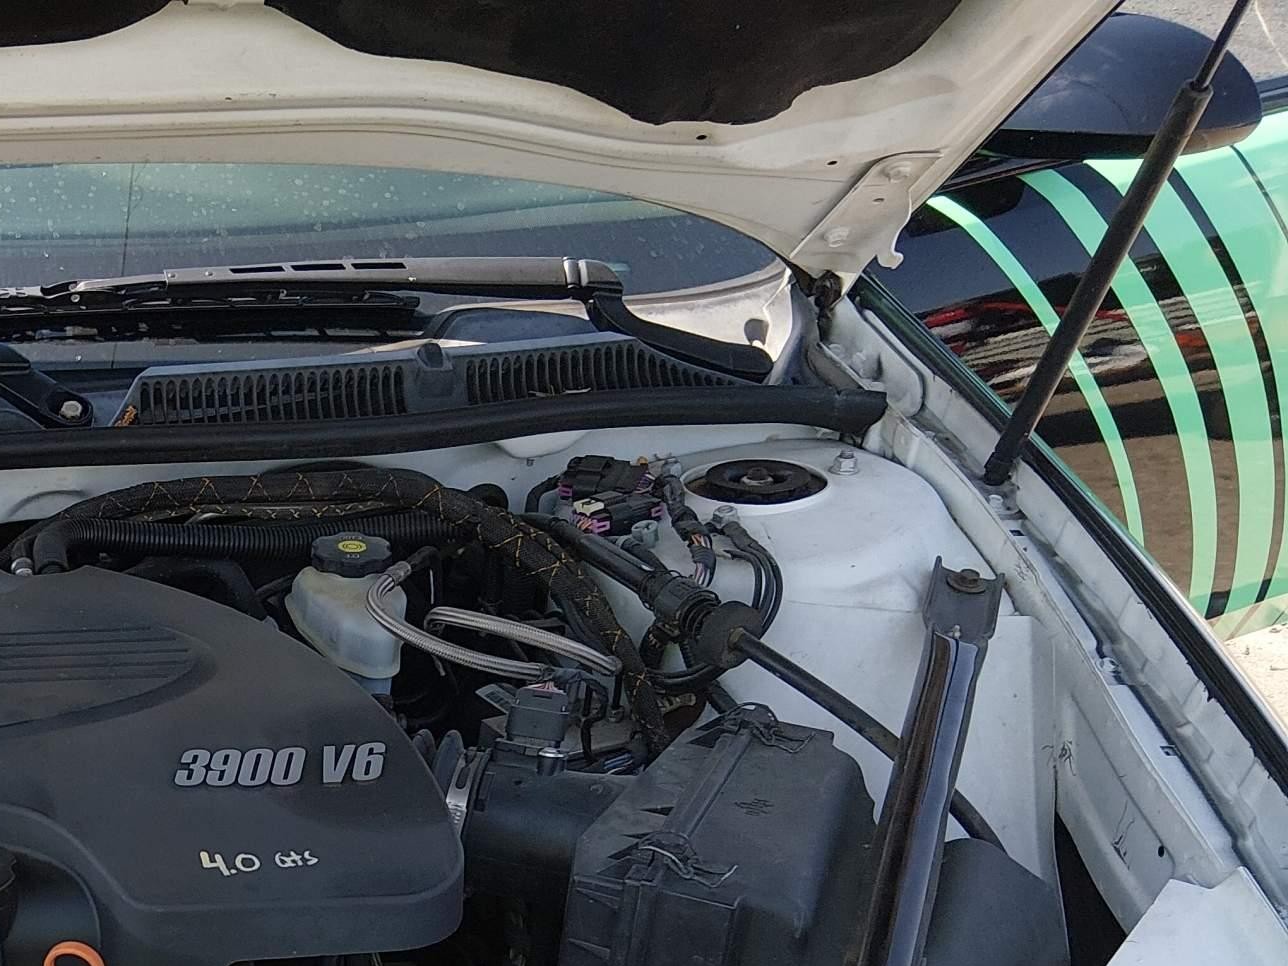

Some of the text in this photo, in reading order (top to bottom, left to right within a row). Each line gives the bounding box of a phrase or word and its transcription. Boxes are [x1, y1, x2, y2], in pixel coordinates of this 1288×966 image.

[174, 742, 386, 787] 3900 V6
[199, 850, 261, 877] 4.0
